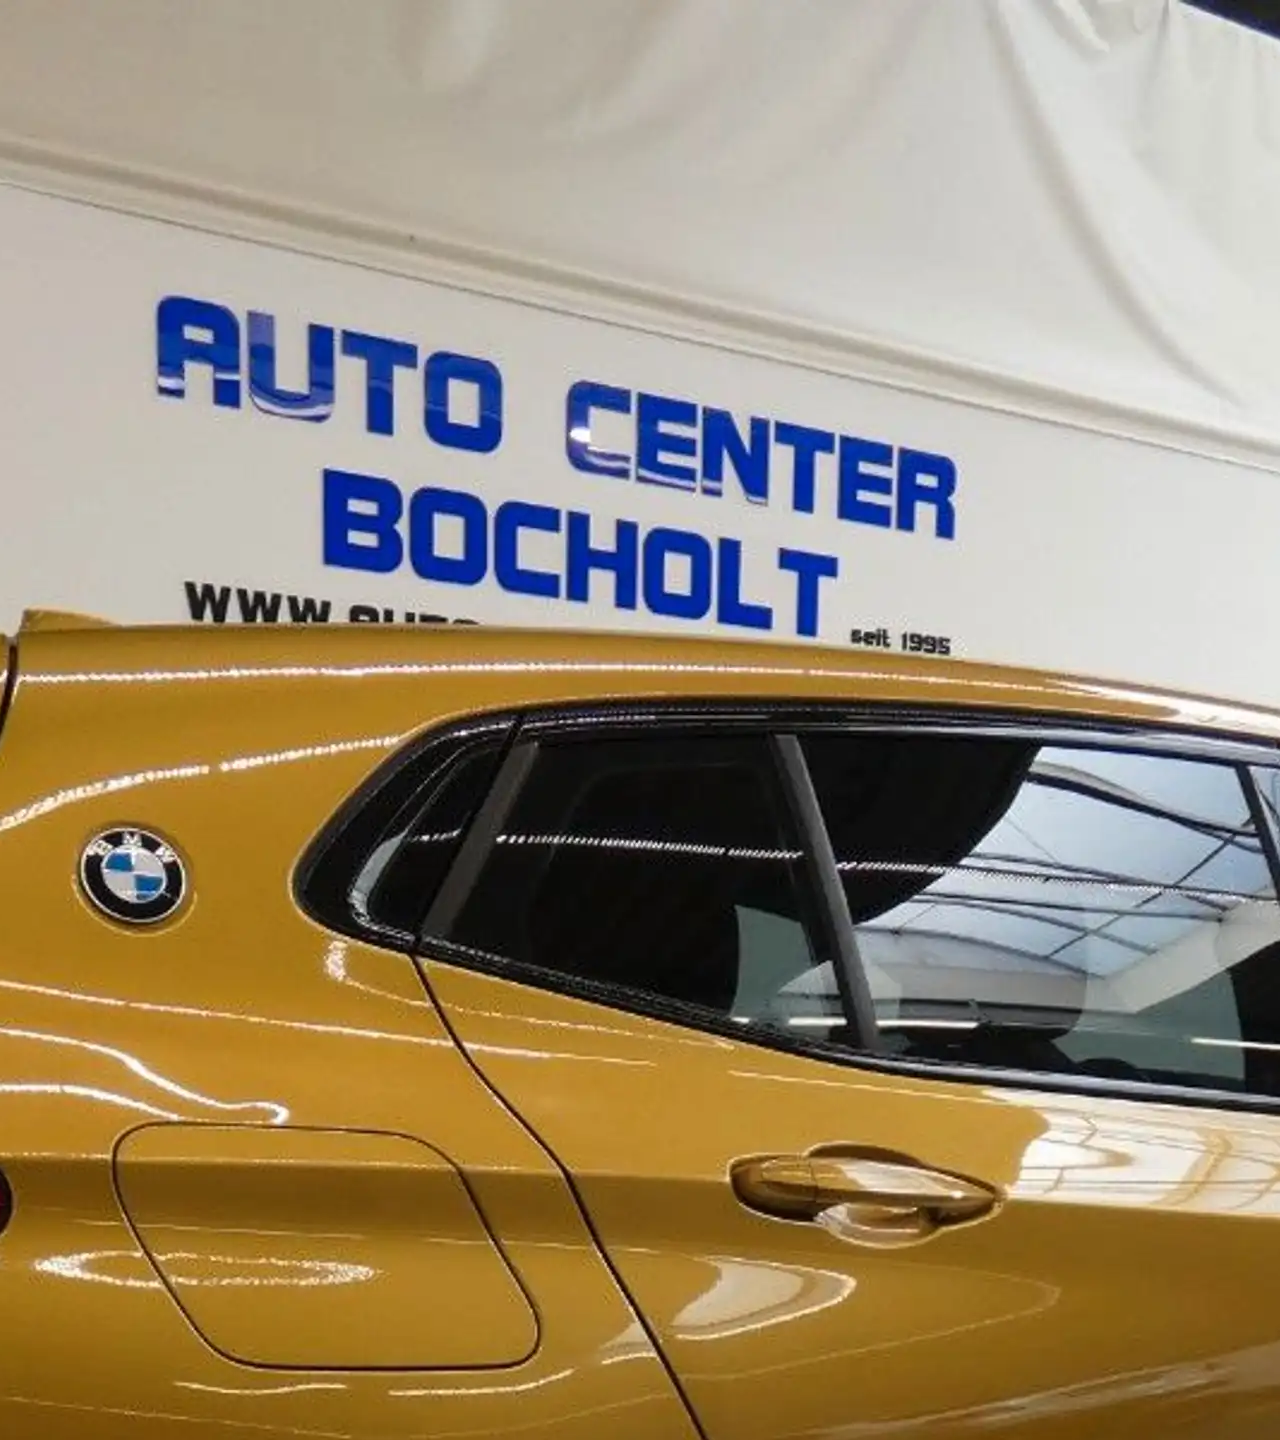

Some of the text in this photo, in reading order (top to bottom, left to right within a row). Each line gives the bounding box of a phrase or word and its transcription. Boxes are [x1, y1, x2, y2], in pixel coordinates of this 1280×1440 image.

[157, 296, 957, 539] AUTO CENTER
[323, 468, 839, 637] BOCHOLT
[850, 627, 951, 656] seit 1995
